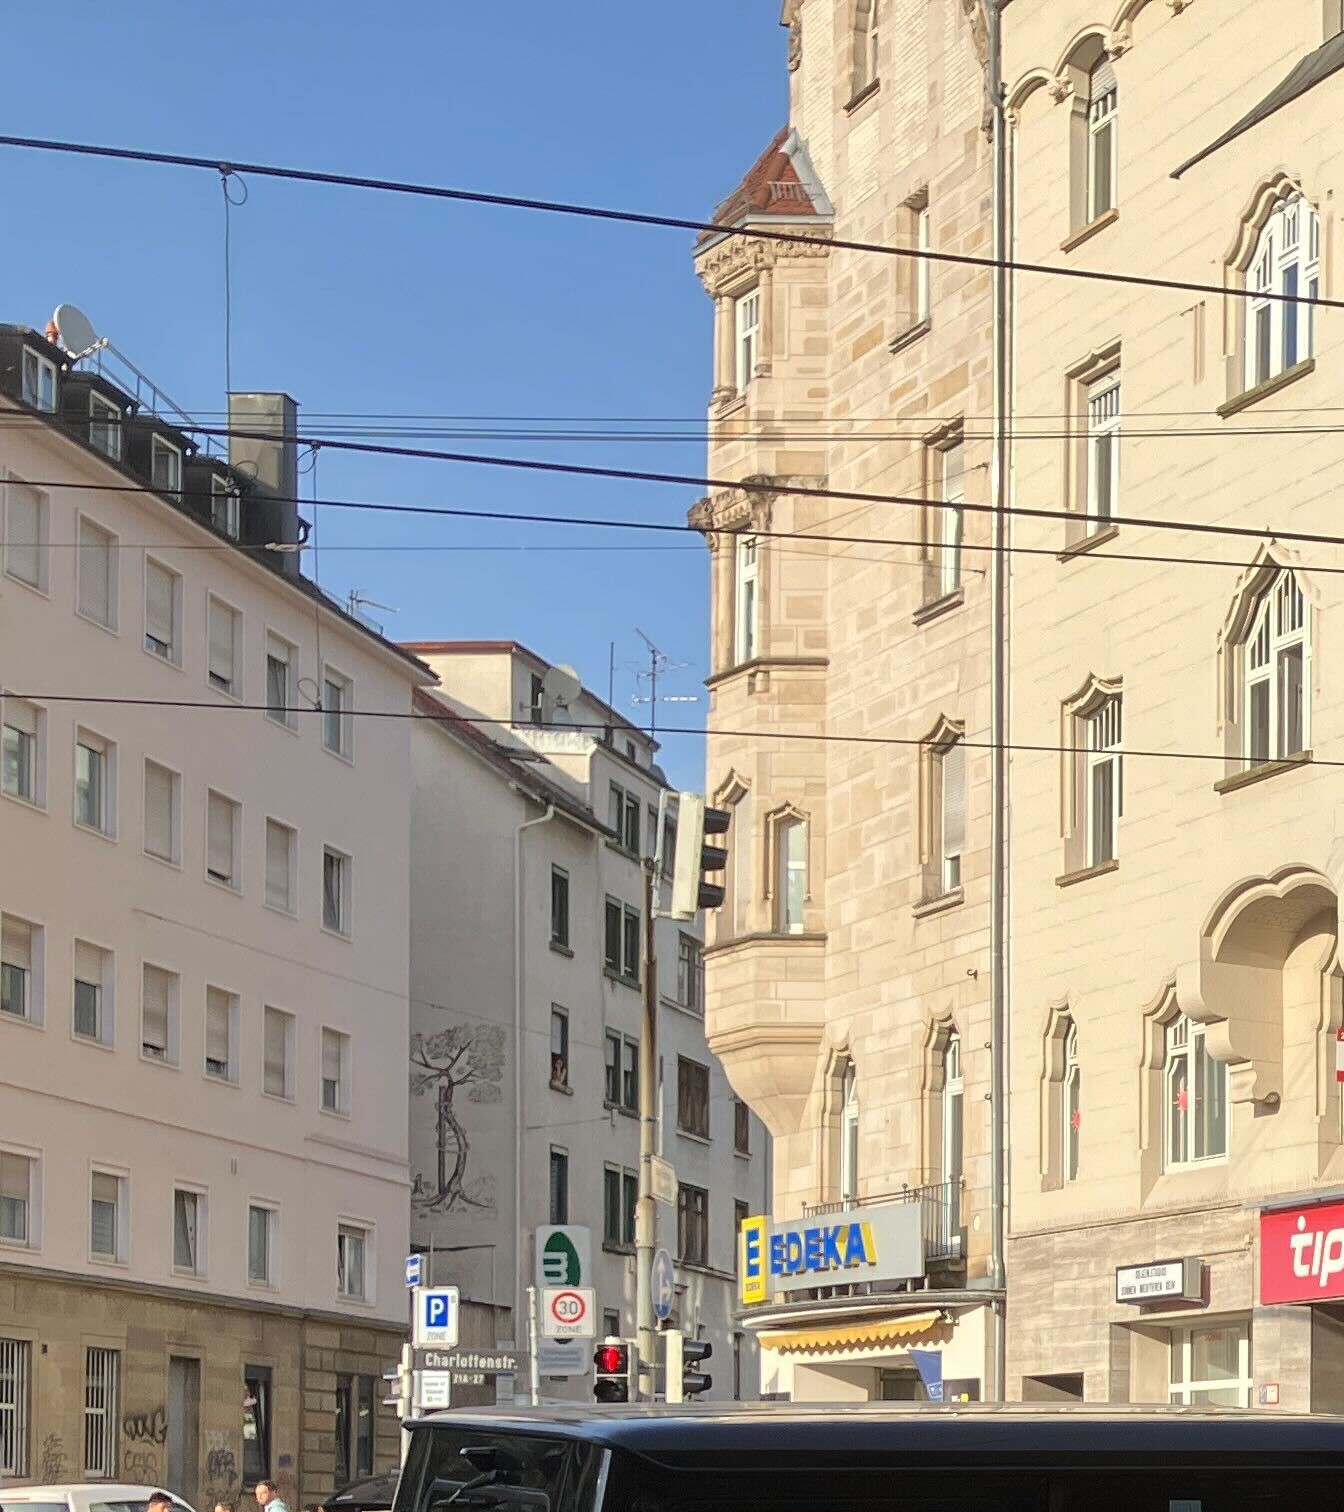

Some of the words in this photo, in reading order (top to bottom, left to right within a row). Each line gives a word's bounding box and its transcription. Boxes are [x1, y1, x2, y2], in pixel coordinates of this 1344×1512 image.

[770, 1222, 877, 1275] EDEKA
[430, 1297, 445, 1325] P
[559, 1301, 578, 1315] 30
[556, 1325, 582, 1334] ZONE
[425, 1352, 519, 1370] Charlottenstr.
